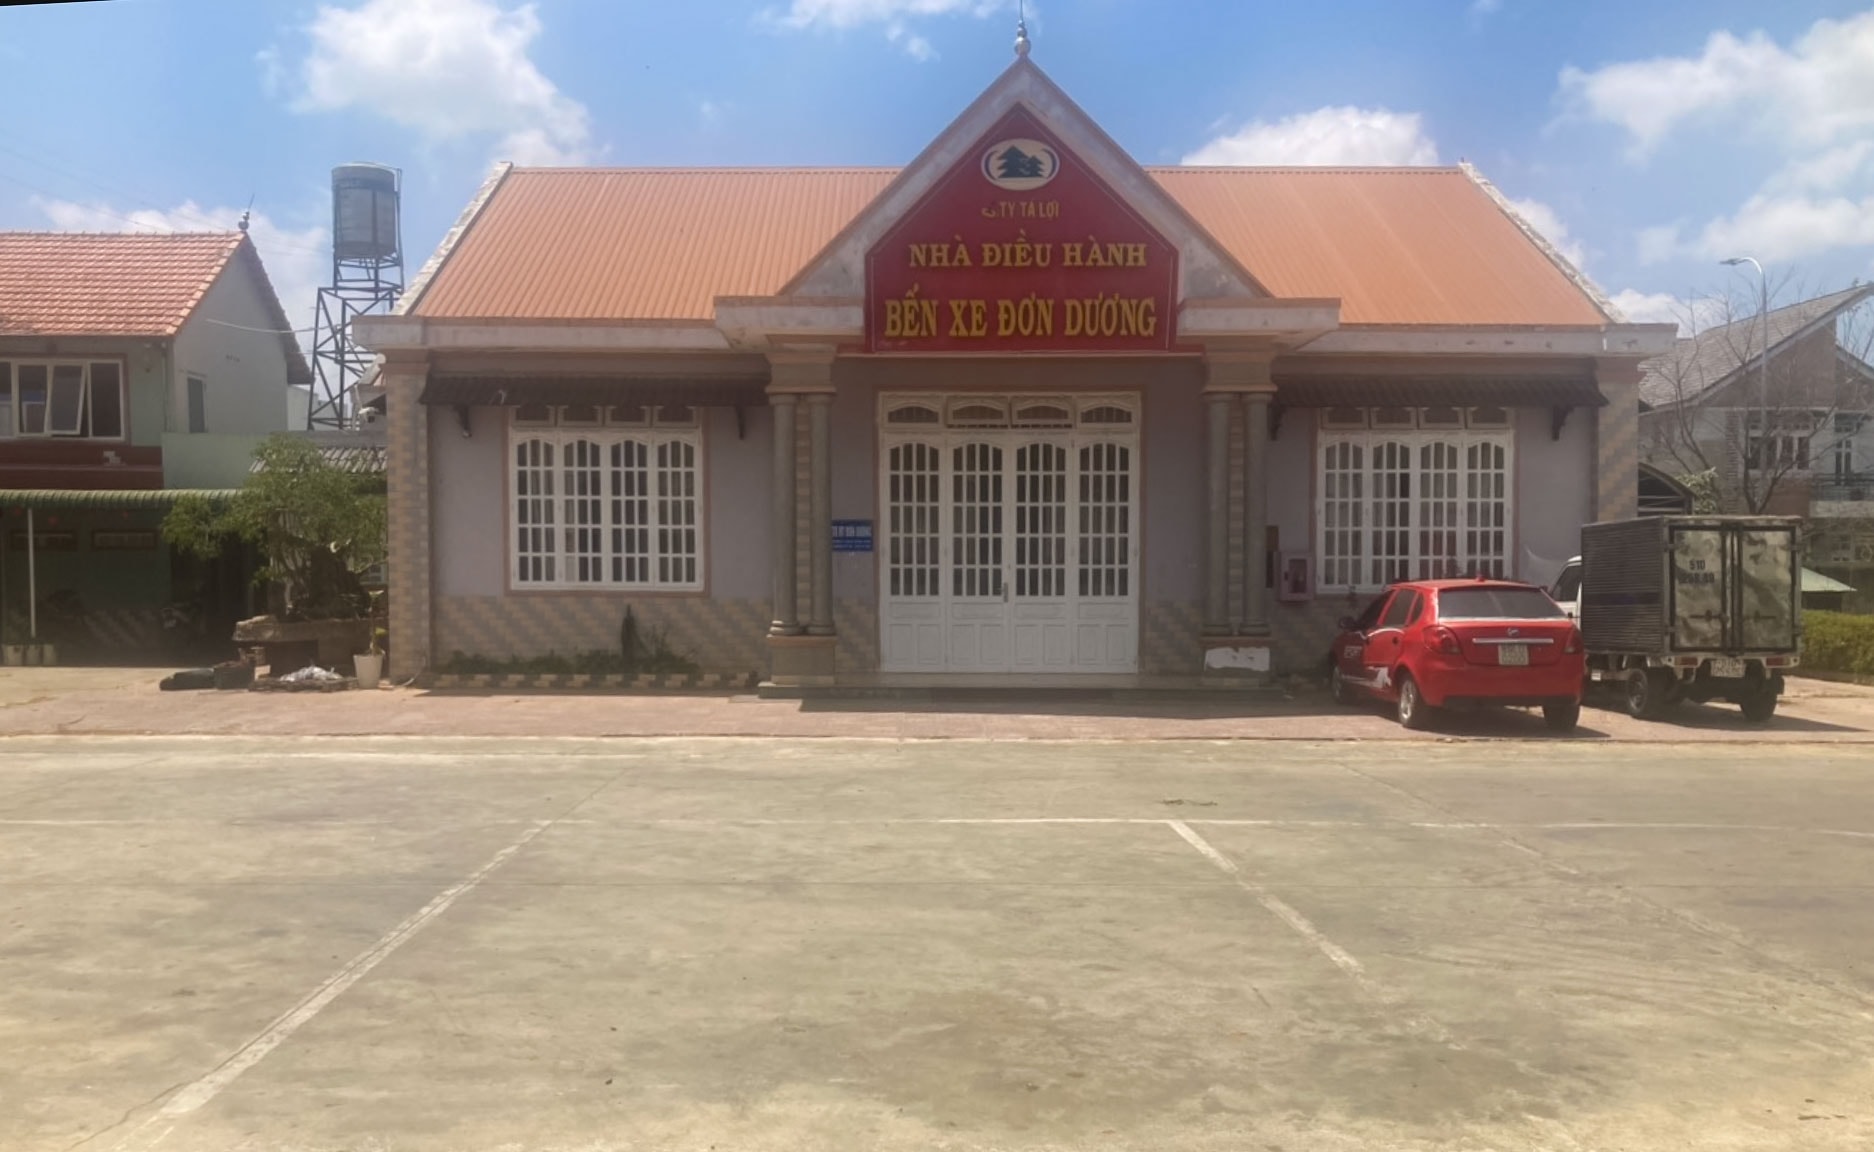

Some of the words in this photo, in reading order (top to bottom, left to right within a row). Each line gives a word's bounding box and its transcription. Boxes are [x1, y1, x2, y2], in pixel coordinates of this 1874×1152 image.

[908, 234, 973, 267] NHÀ
[981, 228, 1053, 267] ĐIỀU
[1061, 234, 1147, 267] HÀNH
[884, 282, 939, 337] BẾN
[948, 299, 988, 337] XE
[997, 291, 1055, 337] ĐƠN
[1063, 291, 1157, 337] DƯƠNG
